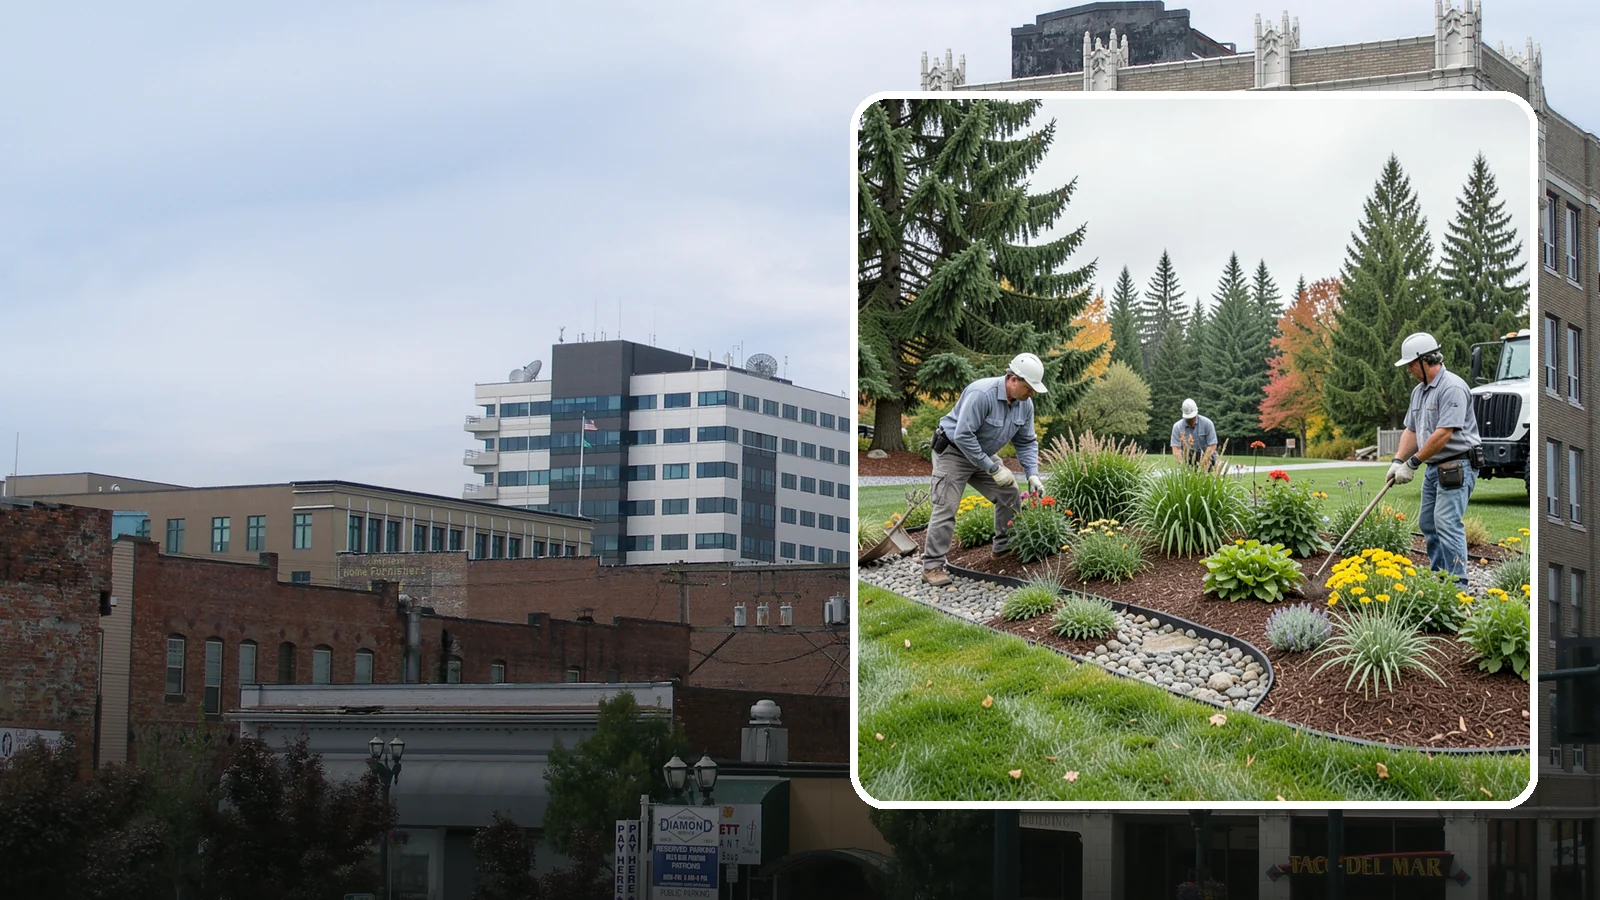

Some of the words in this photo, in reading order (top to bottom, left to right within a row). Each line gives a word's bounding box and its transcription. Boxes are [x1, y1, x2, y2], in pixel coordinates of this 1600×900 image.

[343, 568, 367, 577] Home
[370, 566, 427, 577] Furnishers
[660, 818, 713, 832] DIAMOND
[1022, 815, 1070, 827] BUILDING
[617, 825, 625, 852] PAY
[628, 824, 637, 852] PAY
[689, 846, 716, 854] PARKING
[722, 851, 739, 862] Soup
[671, 862, 701, 870] PATRONS
[1346, 856, 1385, 875] DEL
[1392, 857, 1443, 877] MAR
[616, 856, 625, 893] HERE
[627, 856, 636, 893] HERE
[660, 889, 682, 897] PUBLIC
[683, 889, 710, 898] PARKING
